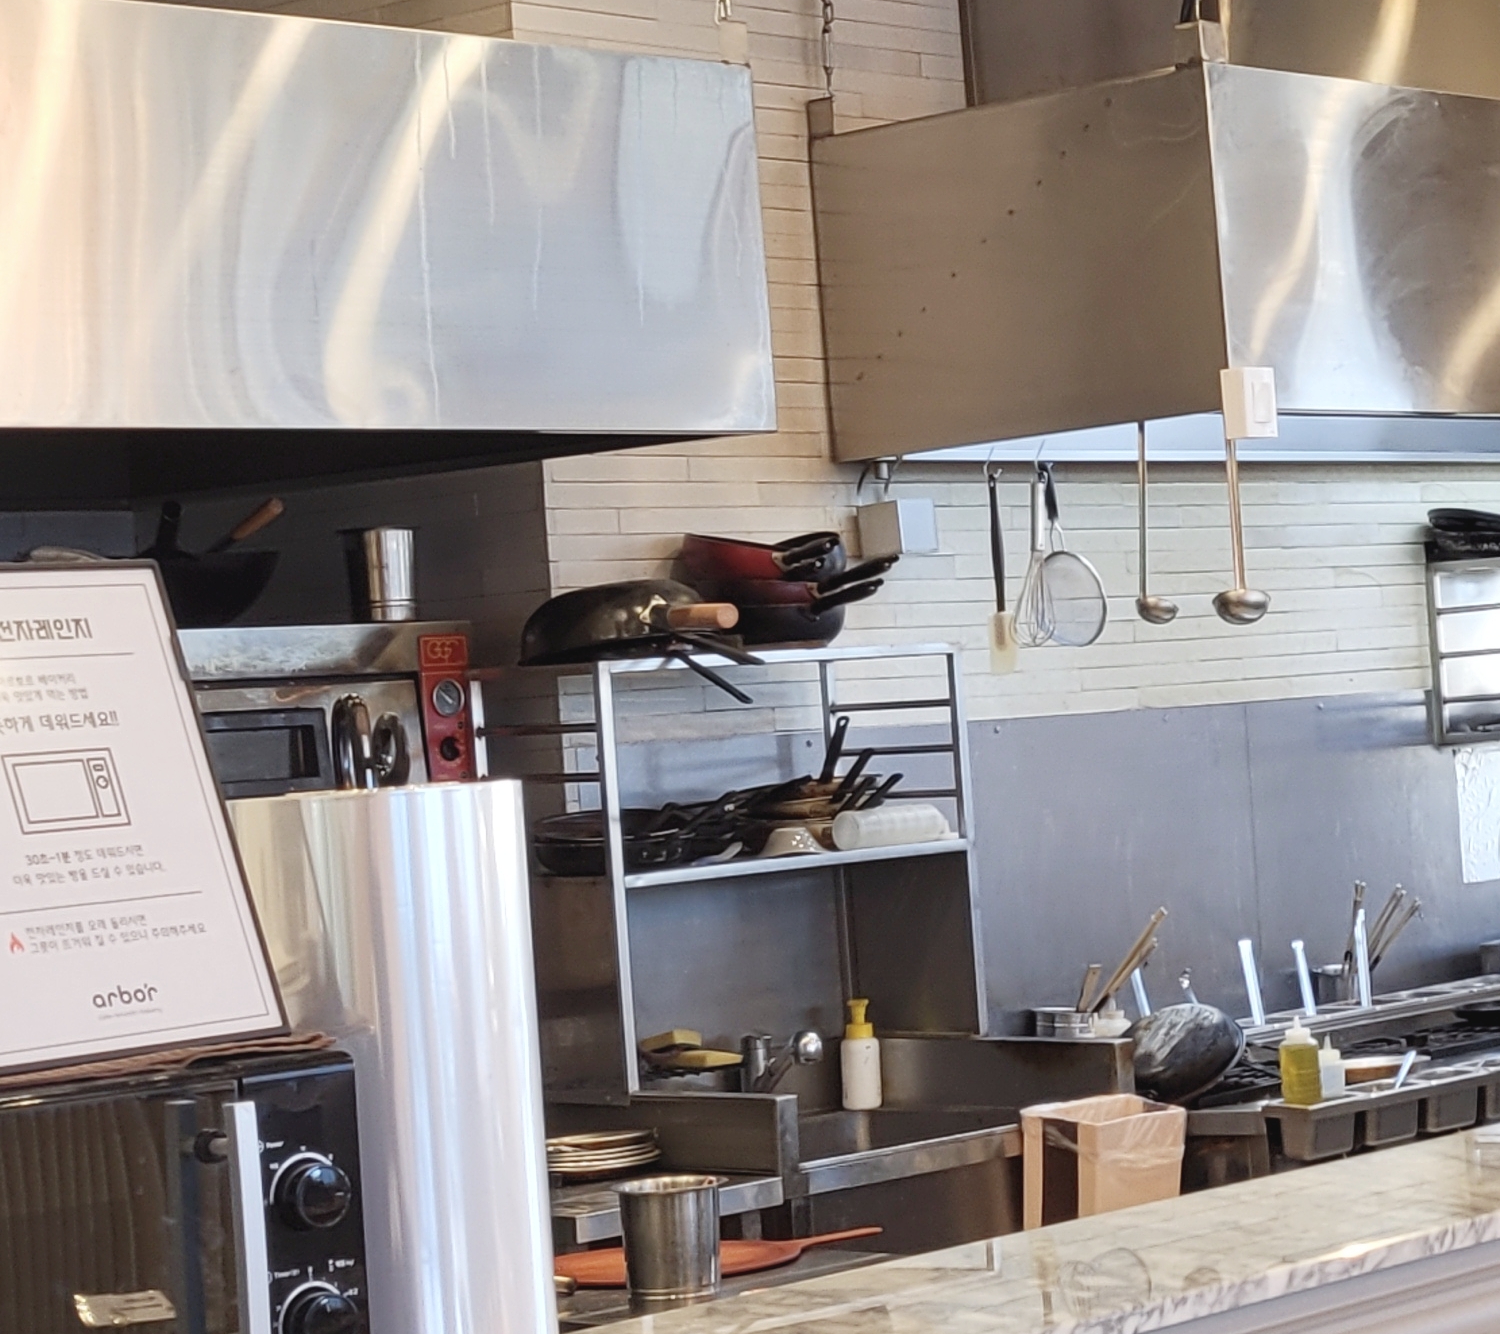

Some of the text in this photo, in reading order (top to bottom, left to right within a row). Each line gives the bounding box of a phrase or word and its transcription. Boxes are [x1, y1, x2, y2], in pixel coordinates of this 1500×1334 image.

[68, 687, 89, 700] 방법
[74, 848, 93, 863] 정도
[91, 866, 110, 879] 드실
[115, 865, 122, 876] 수
